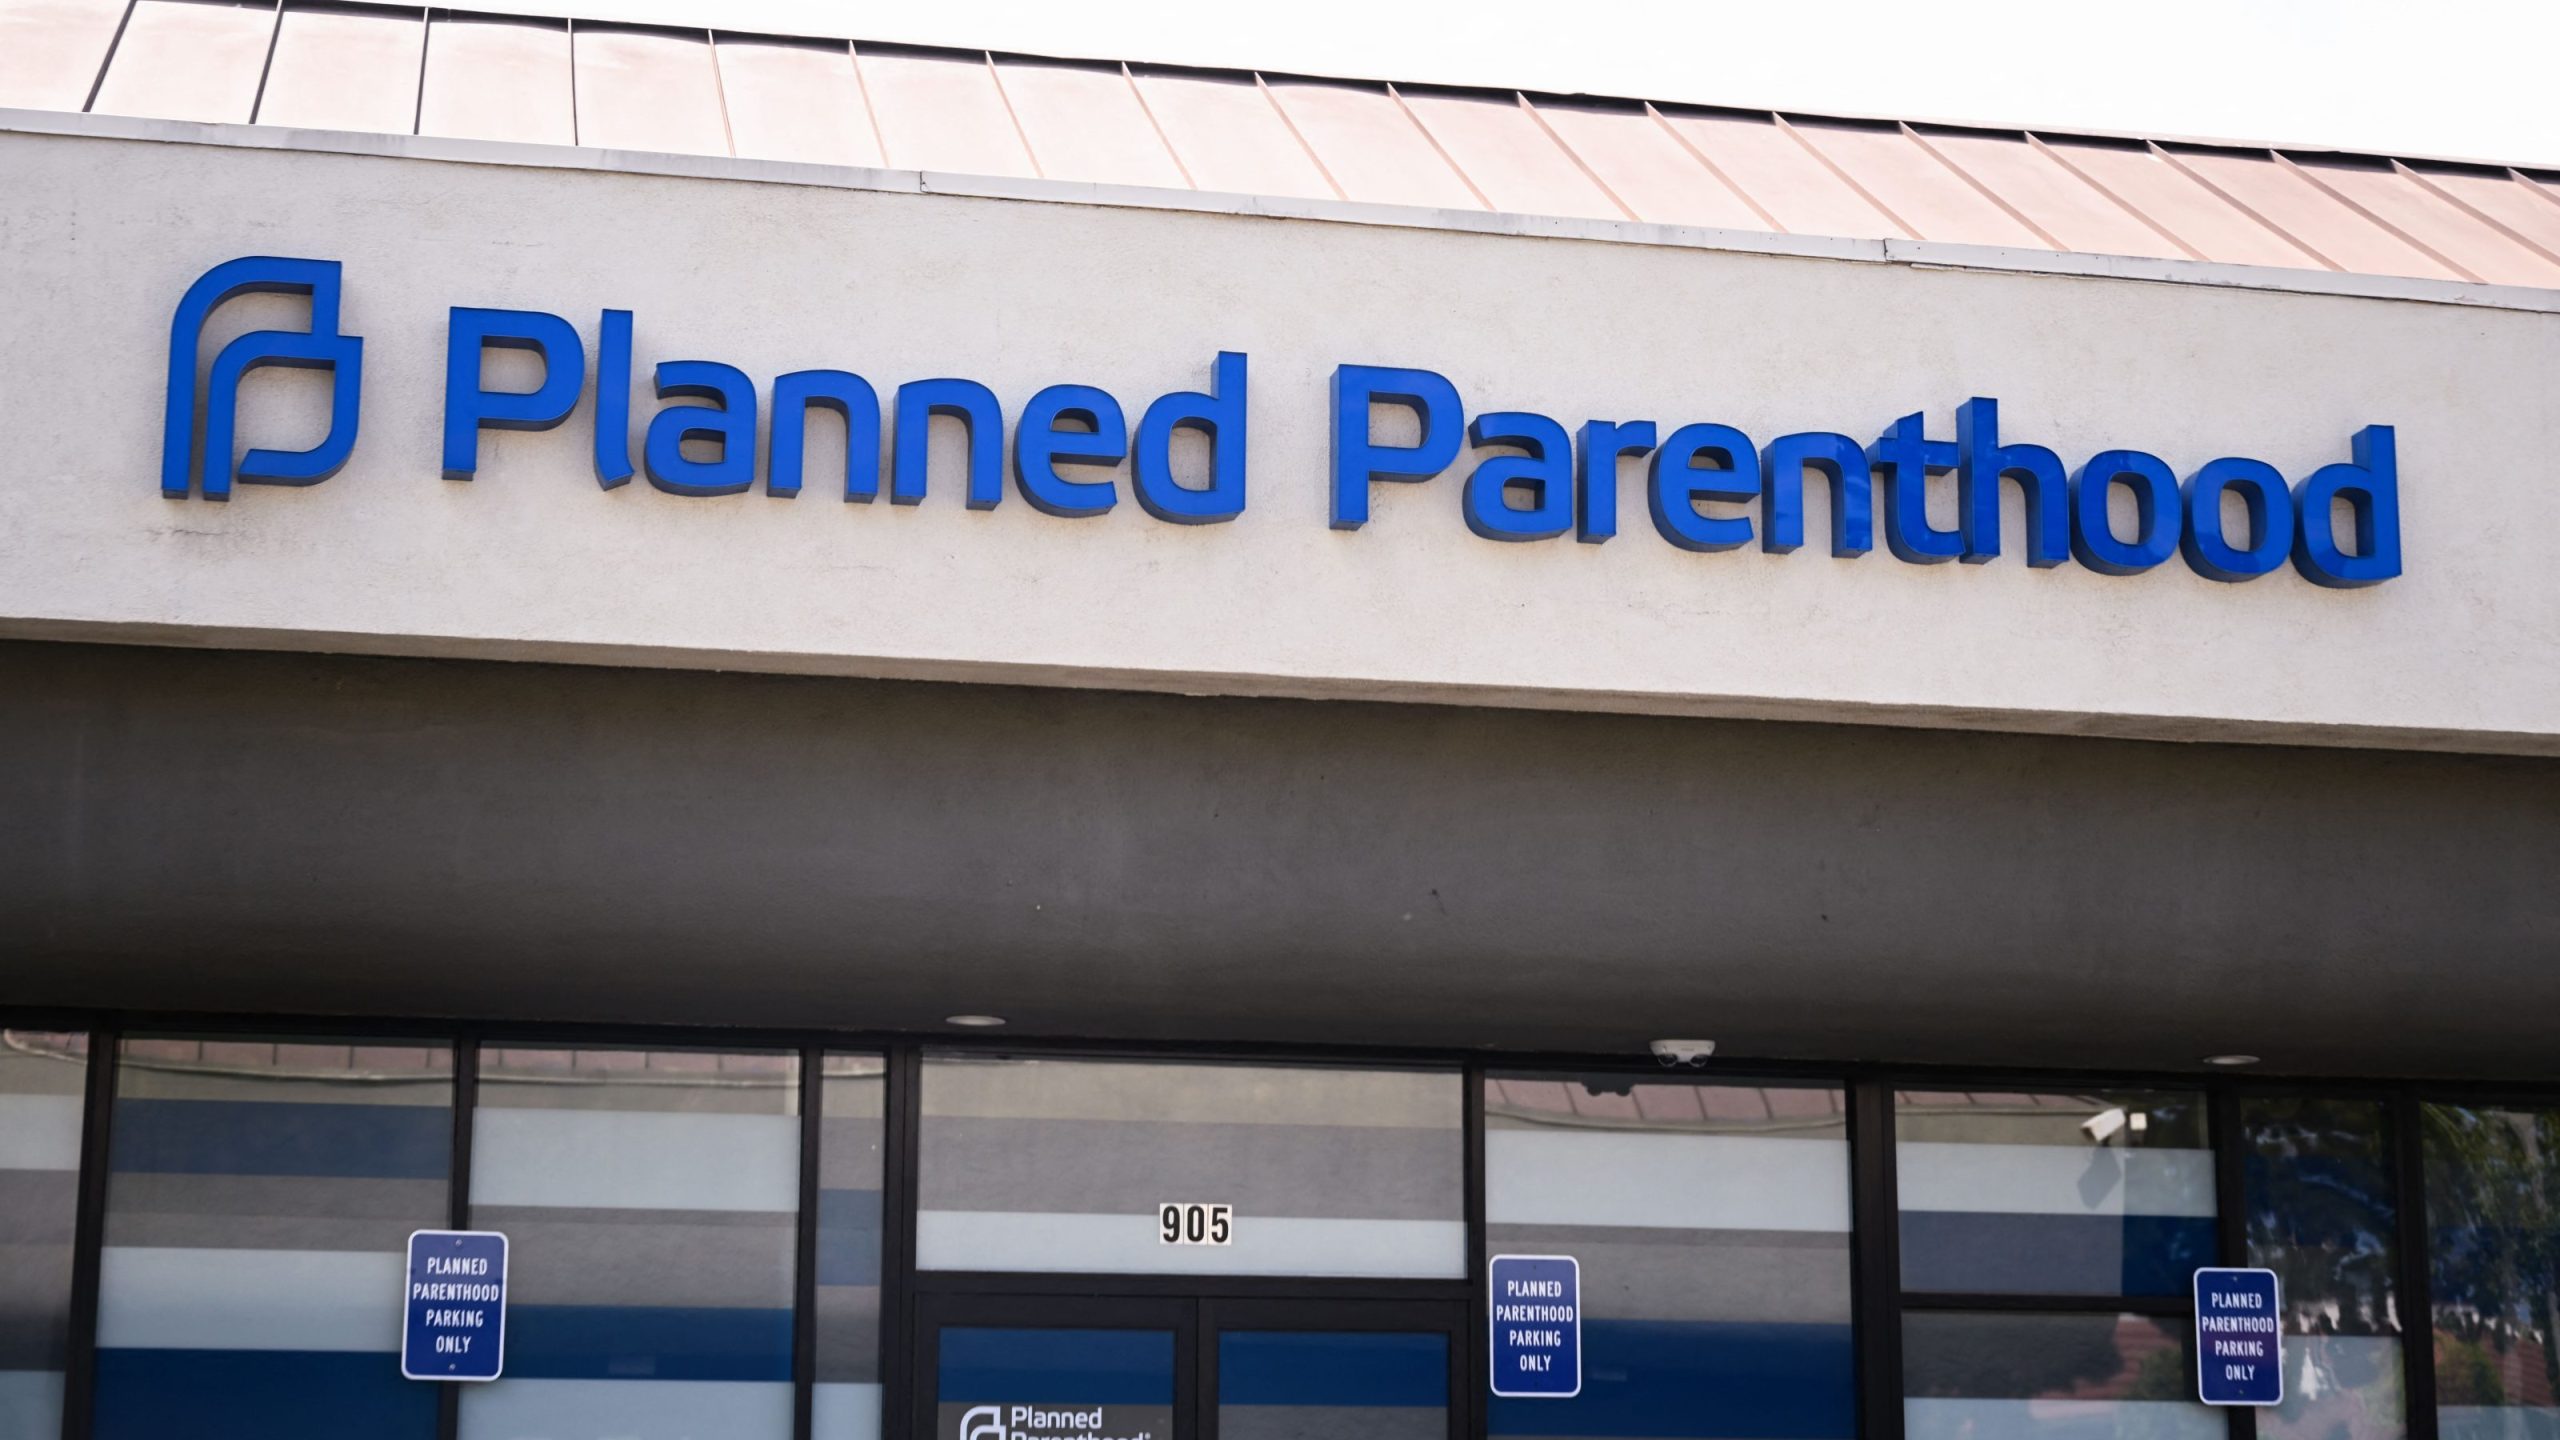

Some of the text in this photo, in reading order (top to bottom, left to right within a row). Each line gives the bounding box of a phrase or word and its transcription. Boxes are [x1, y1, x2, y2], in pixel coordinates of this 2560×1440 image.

[440, 305, 2403, 590] Planned Parenthood
[1162, 1205, 1229, 1243] 905
[426, 1256, 488, 1276] PLANNED
[412, 1282, 500, 1302] PARENTHOOD
[1507, 1279, 1563, 1298] PLANNED
[2211, 1292, 2263, 1309] PLANNED
[425, 1309, 484, 1328] PARKING
[1496, 1304, 1574, 1323] PARENTHOOD
[2201, 1316, 2275, 1333] PARENTHOOD
[435, 1335, 472, 1354] ONLY
[1509, 1329, 1561, 1347] PARKING
[2215, 1340, 2264, 1357] PARKING
[1519, 1354, 1551, 1372] ONLY
[2225, 1364, 2256, 1381] ONLY
[1011, 1405, 1103, 1430] Planned
